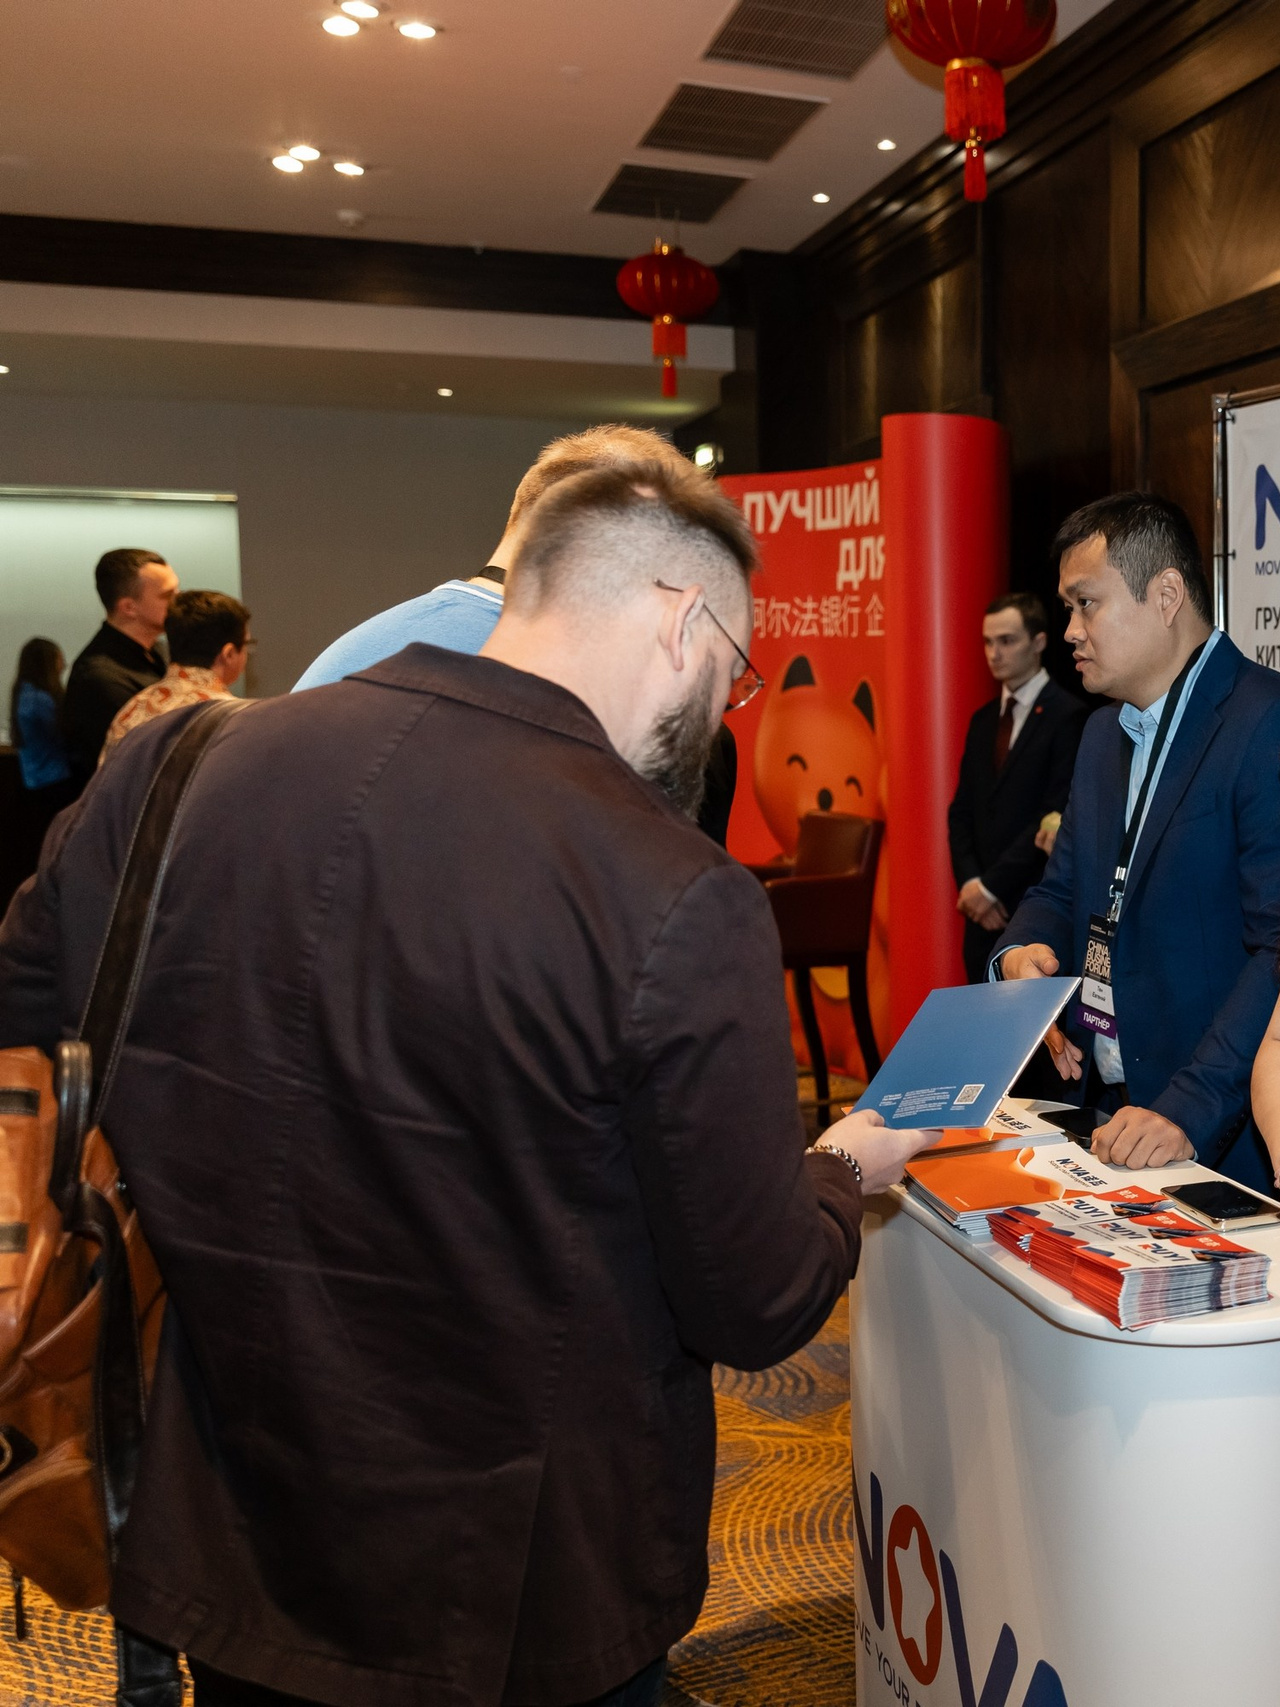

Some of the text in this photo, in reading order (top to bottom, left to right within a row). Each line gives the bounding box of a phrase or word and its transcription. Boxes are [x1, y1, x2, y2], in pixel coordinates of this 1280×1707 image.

[1088, 940, 1109, 957] CHINA
[1085, 961, 1110, 979] FORUM
[1083, 1012, 1110, 1031] ПАРТНЁР
[1063, 1199, 1110, 1217] RUYI
[1098, 1222, 1148, 1239] RUYI
[1138, 1243, 1191, 1262] RUYI
